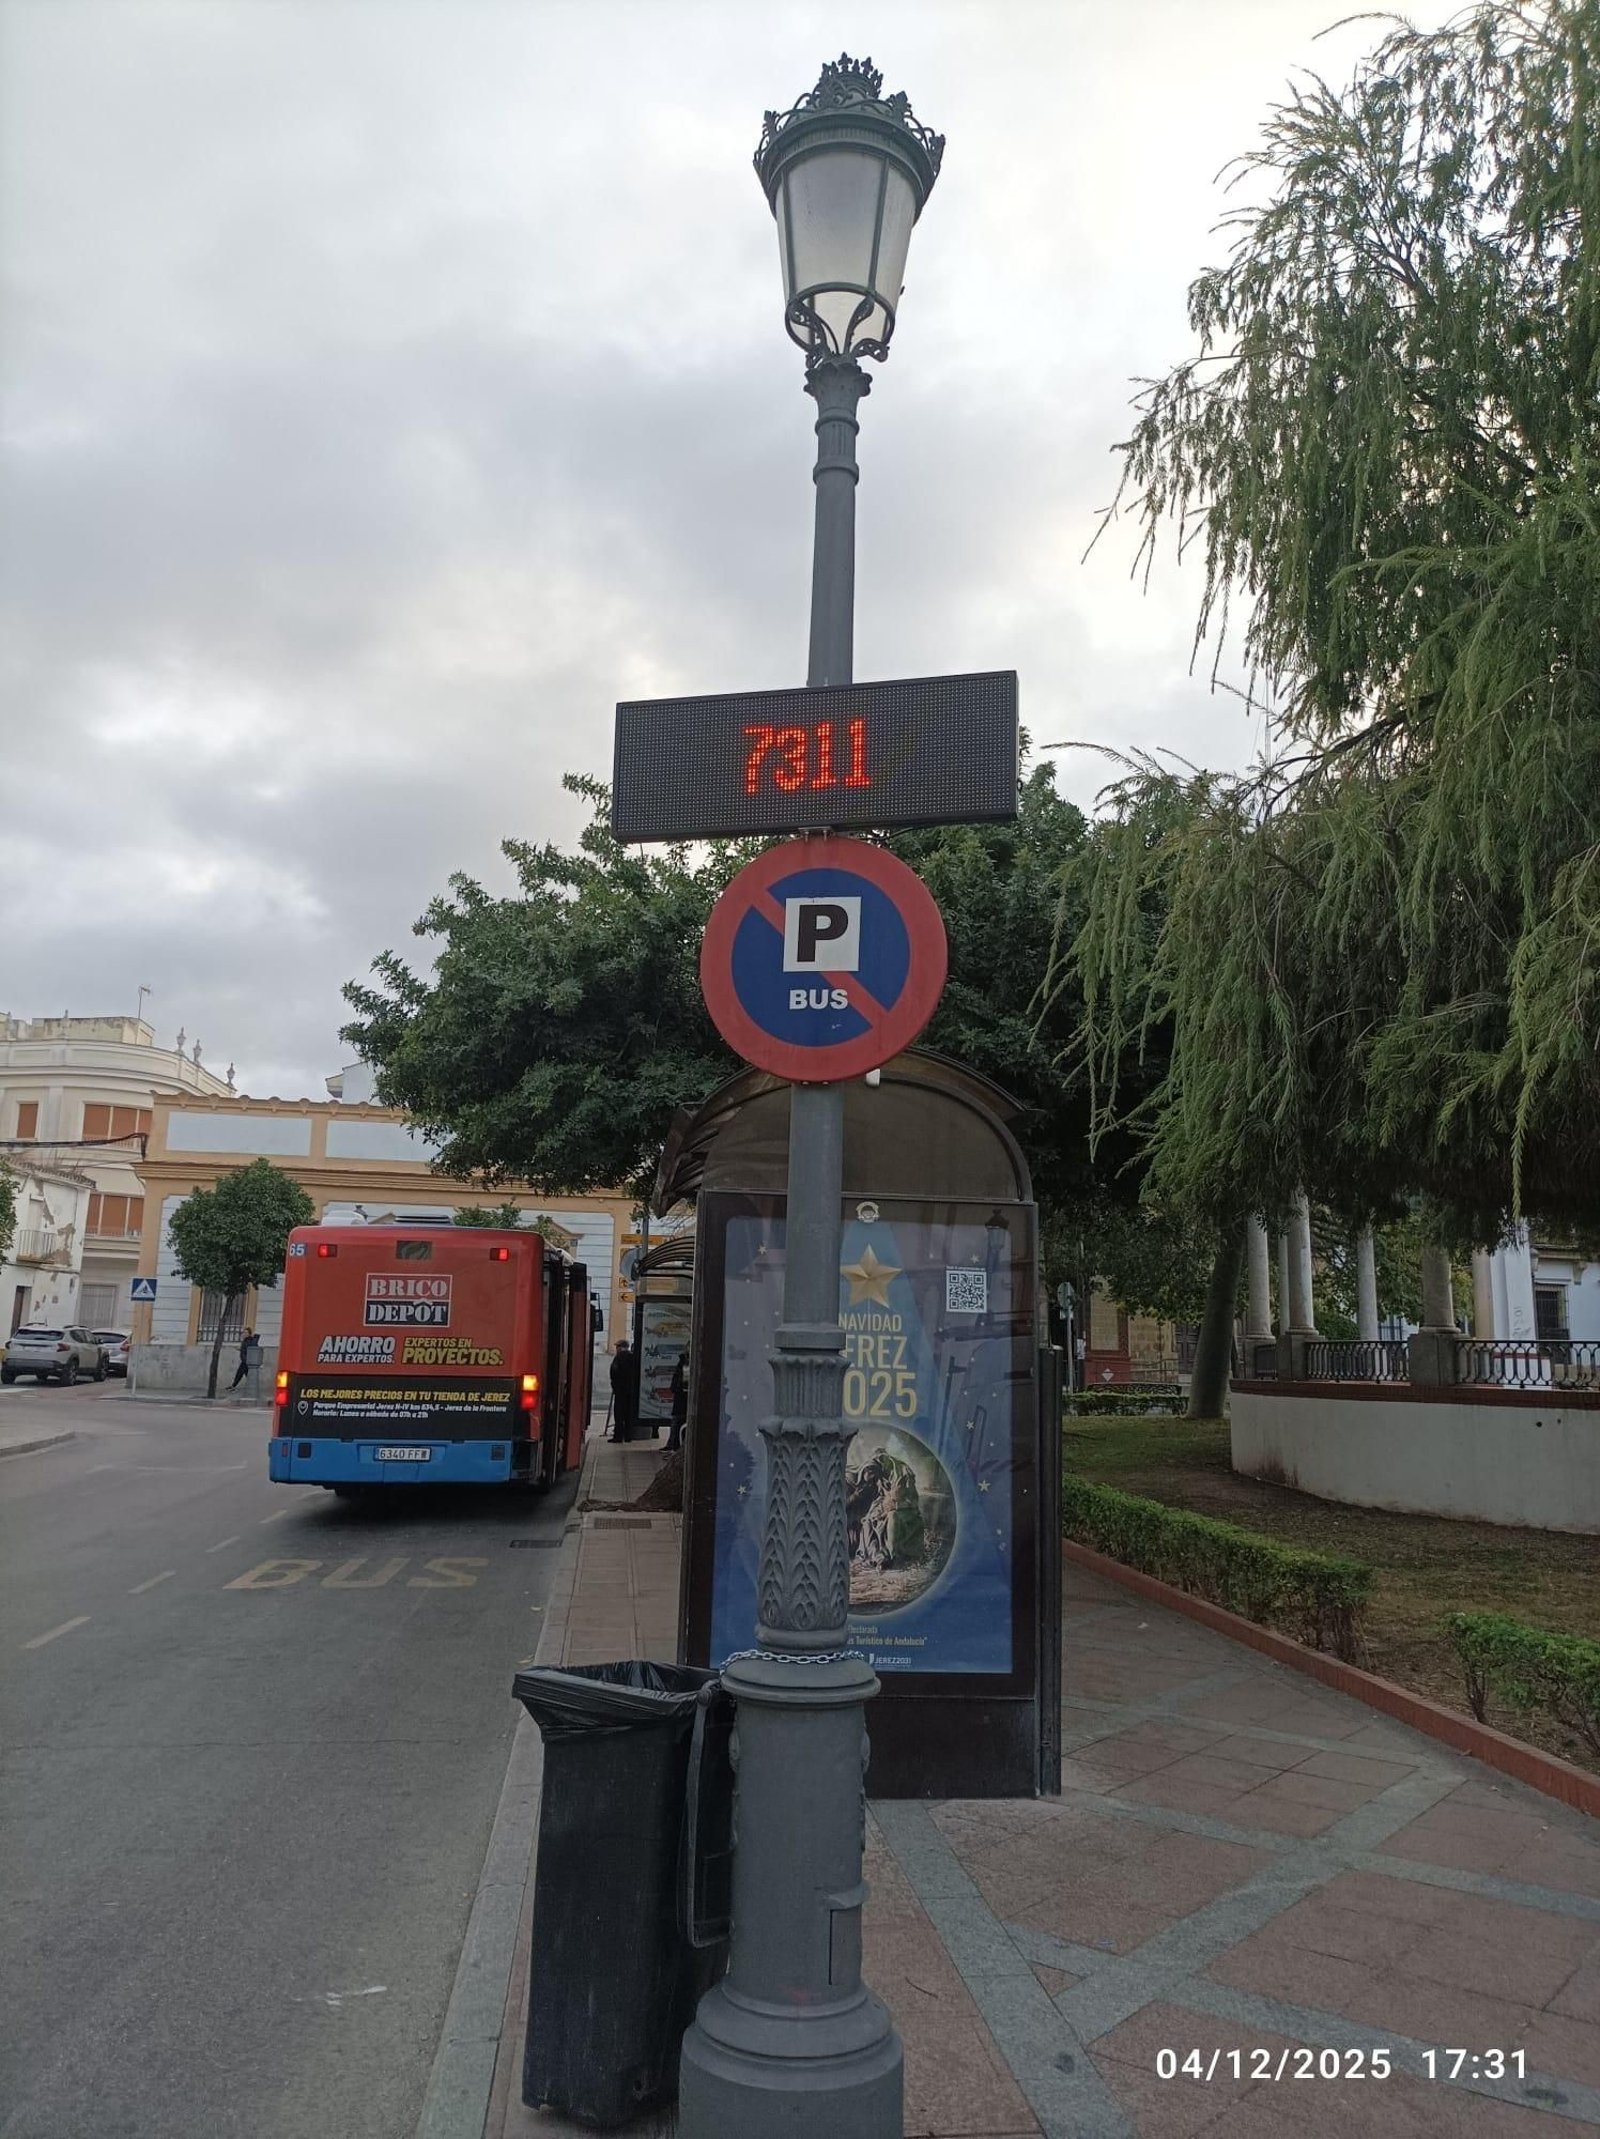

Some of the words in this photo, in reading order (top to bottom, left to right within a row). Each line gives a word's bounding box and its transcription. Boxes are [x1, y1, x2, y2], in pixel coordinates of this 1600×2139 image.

[742, 718, 871, 795] 7311
[796, 904, 849, 963] P
[789, 988, 848, 1011] BUS
[370, 1279, 448, 1298] BRICO
[367, 1298, 447, 1323] DEPÔT
[838, 1312, 902, 1332] NAVIDAD
[320, 1335, 396, 1354] AHORRO
[404, 1337, 457, 1348] EXPERTOS
[457, 1338, 472, 1348] EN
[844, 1334, 908, 1370] EREZ
[317, 1353, 344, 1363] PARA
[344, 1353, 395, 1364] EXPERTOS.
[402, 1347, 504, 1365] PROYECTOS.
[300, 1389, 319, 1399] LOS
[319, 1389, 363, 1400] MEJORES
[363, 1390, 403, 1400] PRECIOS
[403, 1391, 417, 1401] EN
[419, 1391, 431, 1401] TU
[433, 1392, 466, 1402] TIENDA
[467, 1392, 481, 1402] DE
[481, 1393, 511, 1403] JEREZ
[842, 1370, 918, 1418] 025
[380, 1449, 405, 1459] 6340
[222, 1556, 490, 1591] BUS
